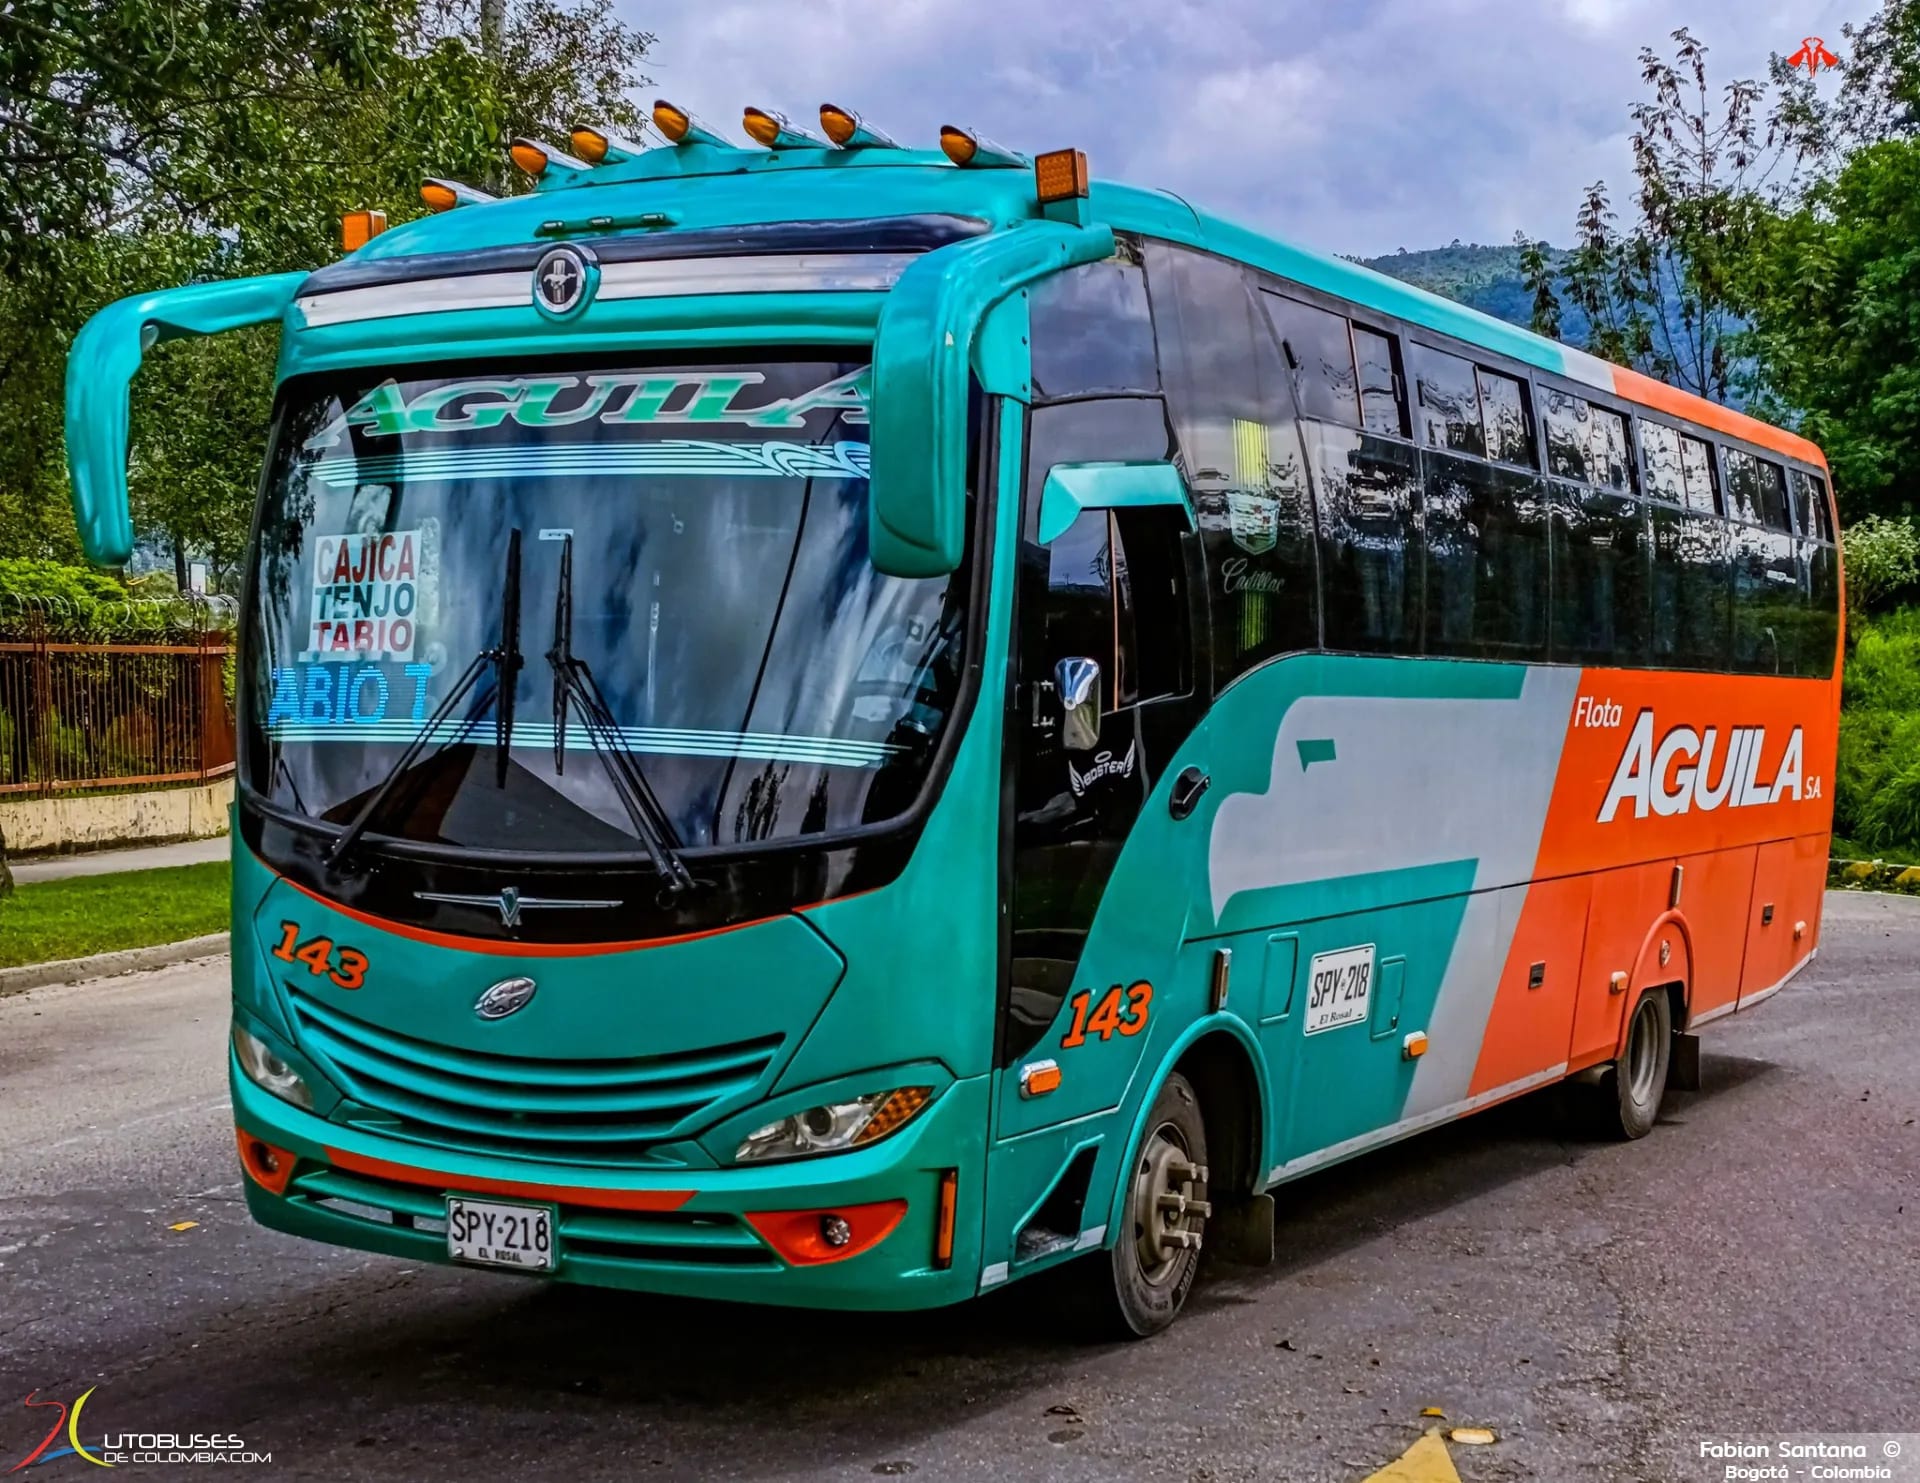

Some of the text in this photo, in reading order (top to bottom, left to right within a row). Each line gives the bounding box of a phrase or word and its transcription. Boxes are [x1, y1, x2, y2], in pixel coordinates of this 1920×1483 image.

[317, 534, 415, 584] CAJICA
[1221, 557, 1285, 594] Cadillac
[315, 582, 415, 620] TENJO
[313, 618, 413, 652] TABIO
[268, 666, 389, 728] ABIO
[1574, 696, 1623, 728] Flota
[1596, 707, 1822, 823] AGUILA SA
[272, 920, 370, 991] 143
[1060, 980, 1153, 1050] 143
[1320, 1007, 1353, 1024] El Rosal
